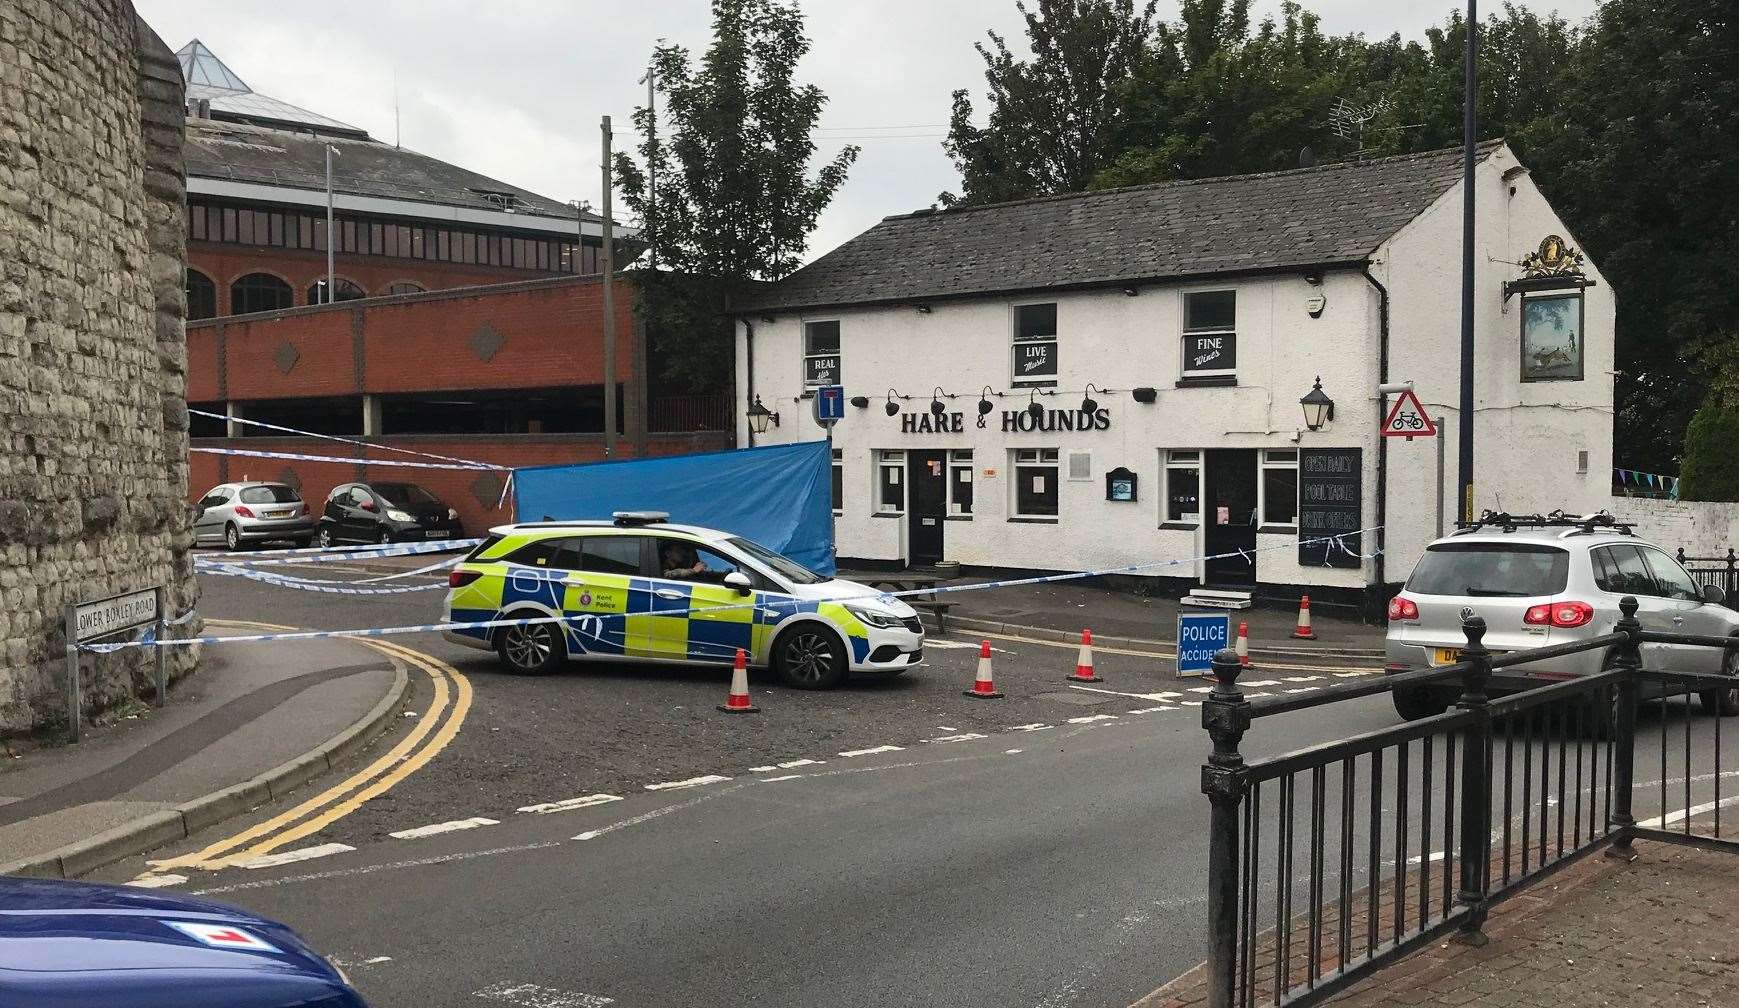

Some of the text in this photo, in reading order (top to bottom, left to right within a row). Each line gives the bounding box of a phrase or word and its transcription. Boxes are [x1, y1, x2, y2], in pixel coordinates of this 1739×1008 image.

[1197, 337, 1223, 350] FINE
[1026, 346, 1047, 357] LIVE
[1194, 350, 1220, 366] Wines
[815, 359, 836, 370] REAL
[1024, 357, 1046, 372] Music
[901, 408, 1111, 434] HARE & HOUNDS
[106, 602, 133, 623] BOXLEY
[135, 597, 154, 615] ROAD
[1182, 625, 1225, 641] POLICE
[1181, 649, 1217, 661] ACCIDE
